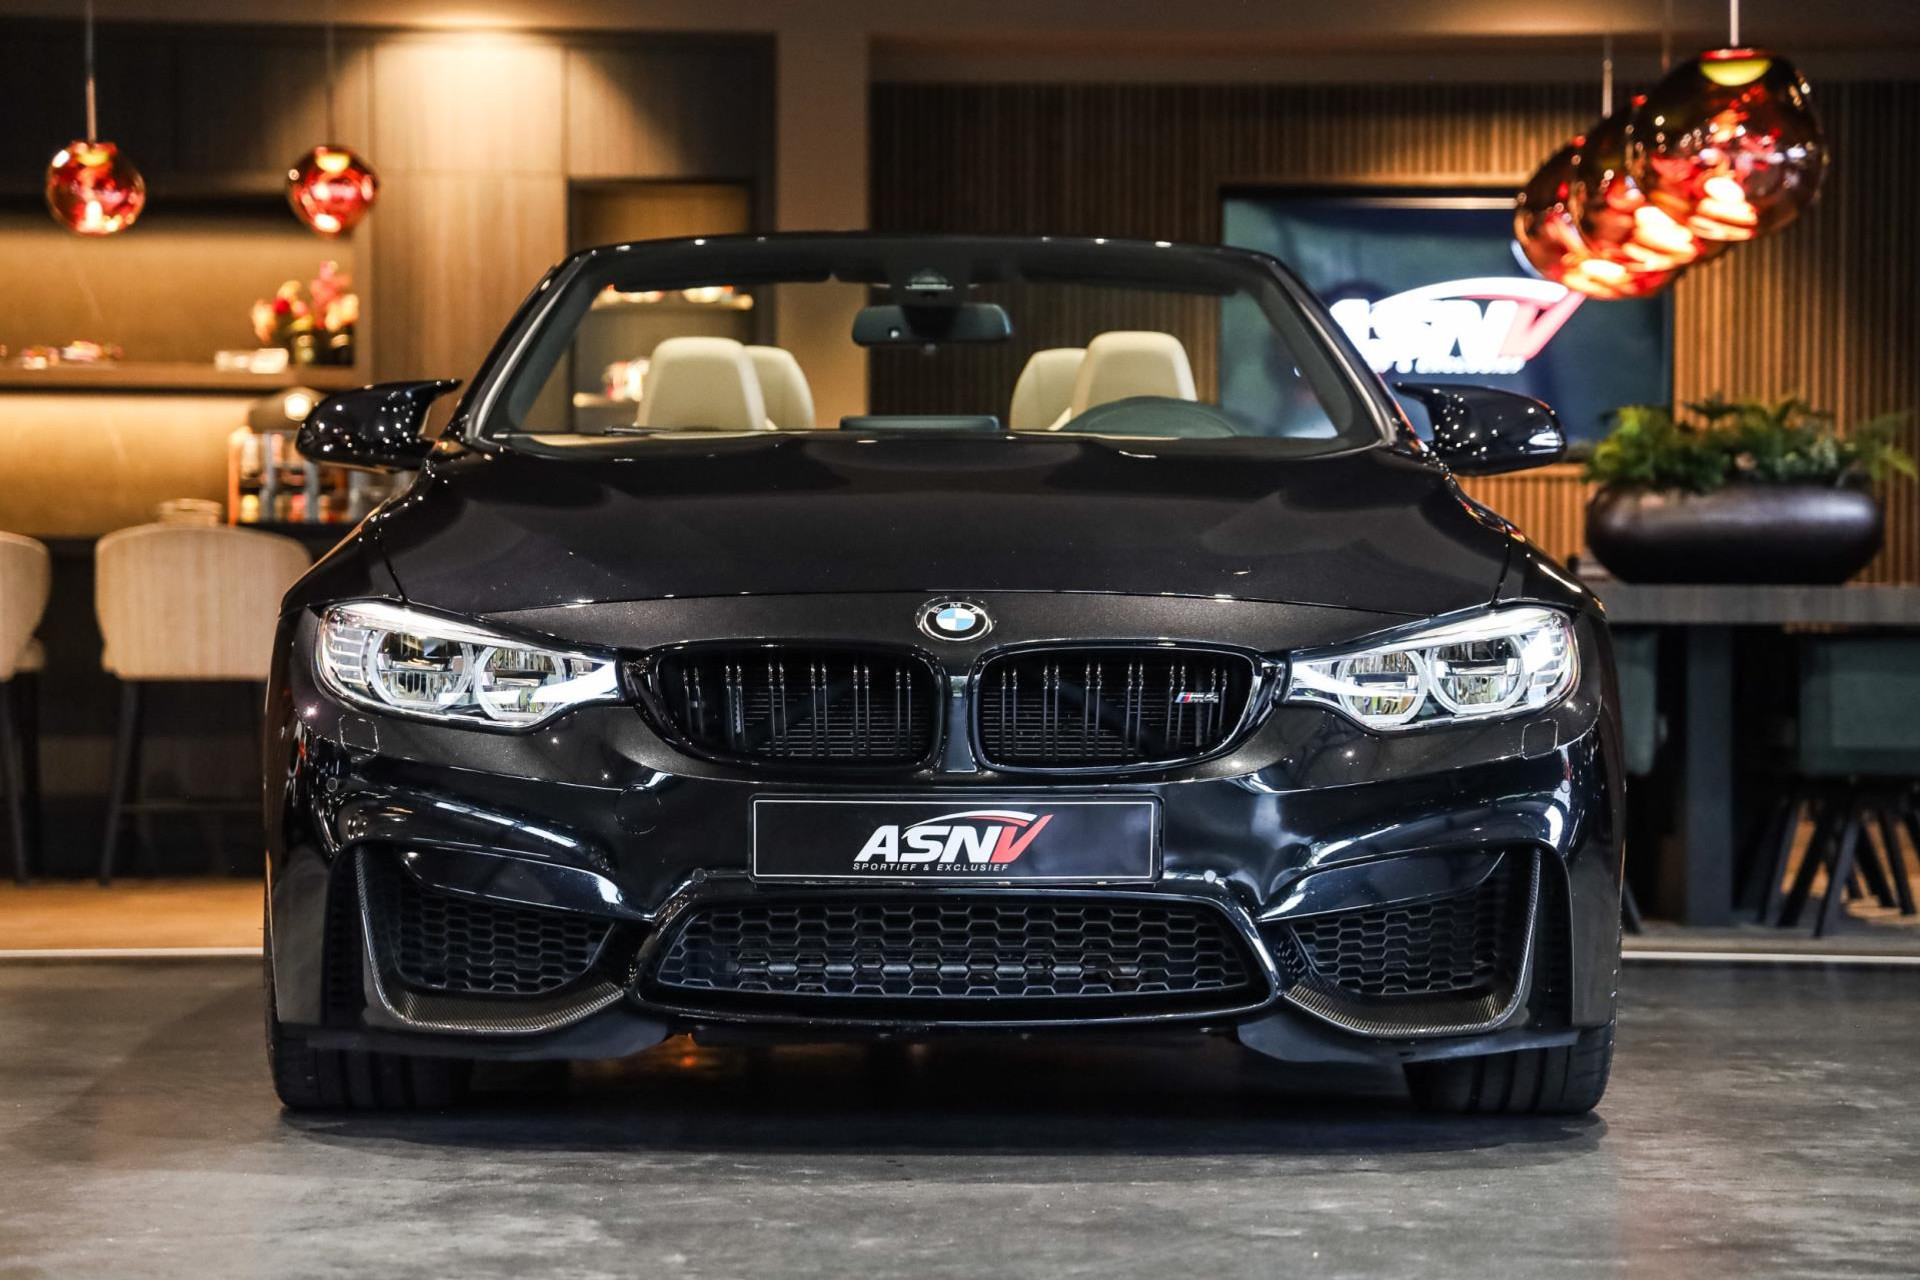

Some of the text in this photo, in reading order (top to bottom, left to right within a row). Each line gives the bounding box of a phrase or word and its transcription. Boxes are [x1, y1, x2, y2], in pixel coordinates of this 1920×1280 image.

[930, 602, 985, 615] BMW
[853, 812, 1054, 863] ASNV
[852, 862, 1009, 872] SPORTIEF & EXCLUSIEF
